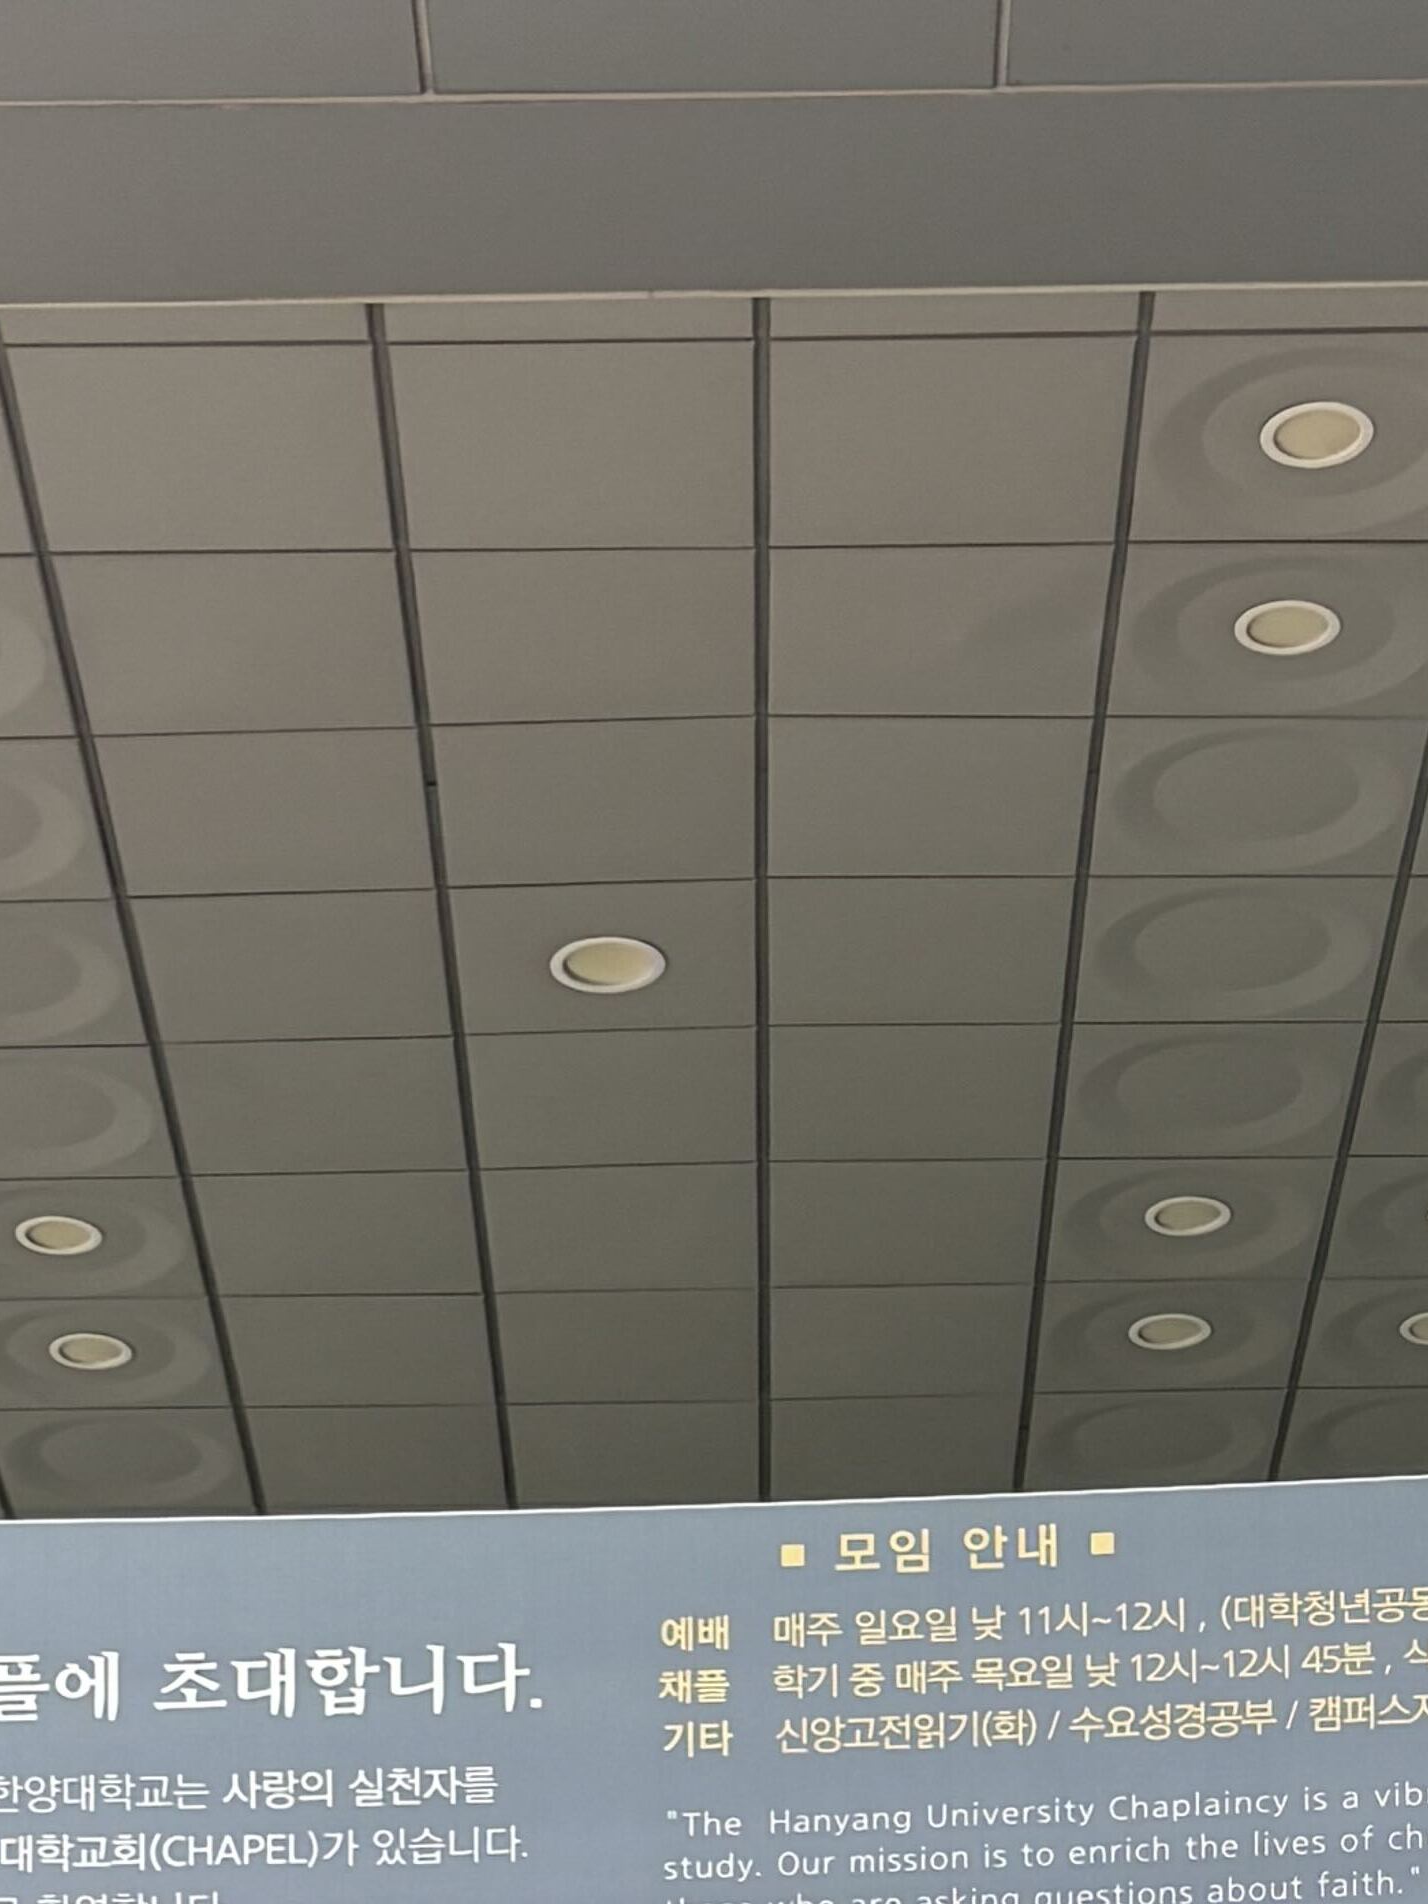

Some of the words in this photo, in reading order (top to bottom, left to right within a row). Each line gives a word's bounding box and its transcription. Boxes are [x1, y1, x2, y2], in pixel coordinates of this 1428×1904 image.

[834, 1527, 930, 1573] 모임
[963, 1522, 1058, 1570] 안내
[660, 1614, 730, 1652] 예배
[773, 1611, 844, 1649] 매주
[855, 1605, 958, 1646] 일요일
[971, 1604, 1007, 1641] 낮
[152, 1642, 543, 1718] 초대합니다.
[658, 1669, 731, 1705] 채플
[772, 1662, 838, 1700] 학기
[848, 1662, 886, 1698] 중
[895, 1659, 964, 1695] 매주
[970, 1653, 1074, 1692] 목요일
[1085, 1651, 1121, 1688] 낮
[1130, 1643, 1290, 1684] 12시~12시
[663, 1719, 734, 1758] 기타
[775, 1708, 1038, 1754] 신앙고전읽기(화)
[1068, 1698, 1278, 1744] 수요성경공부
[222, 1768, 333, 1810] 사랑의
[348, 1765, 499, 1808] 실천자를
[666, 1810, 743, 1837] "The
[769, 1808, 912, 1837] Hanyang
[927, 1796, 1095, 1829] University
[1108, 1789, 1289, 1823] Chaplaincy
[1303, 1785, 1328, 1812] is
[1342, 1790, 1359, 1810] a
[0, 1828, 360, 1873] 대학교회(CHAPEL)가
[372, 1824, 528, 1866] 있습니다.
[663, 1851, 762, 1883] study.
[777, 1850, 836, 1876] Our
[849, 1845, 969, 1873] mission
[983, 1843, 1008, 1869] is
[1020, 1843, 1055, 1868] to
[1068, 1835, 1170, 1865] enrich
[1185, 1832, 1239, 1861] the
[1254, 1829, 1326, 1857] lives
[1340, 1823, 1374, 1853] of
[1207, 1875, 1303, 1904] about
[1317, 1865, 1420, 1898] faith."
